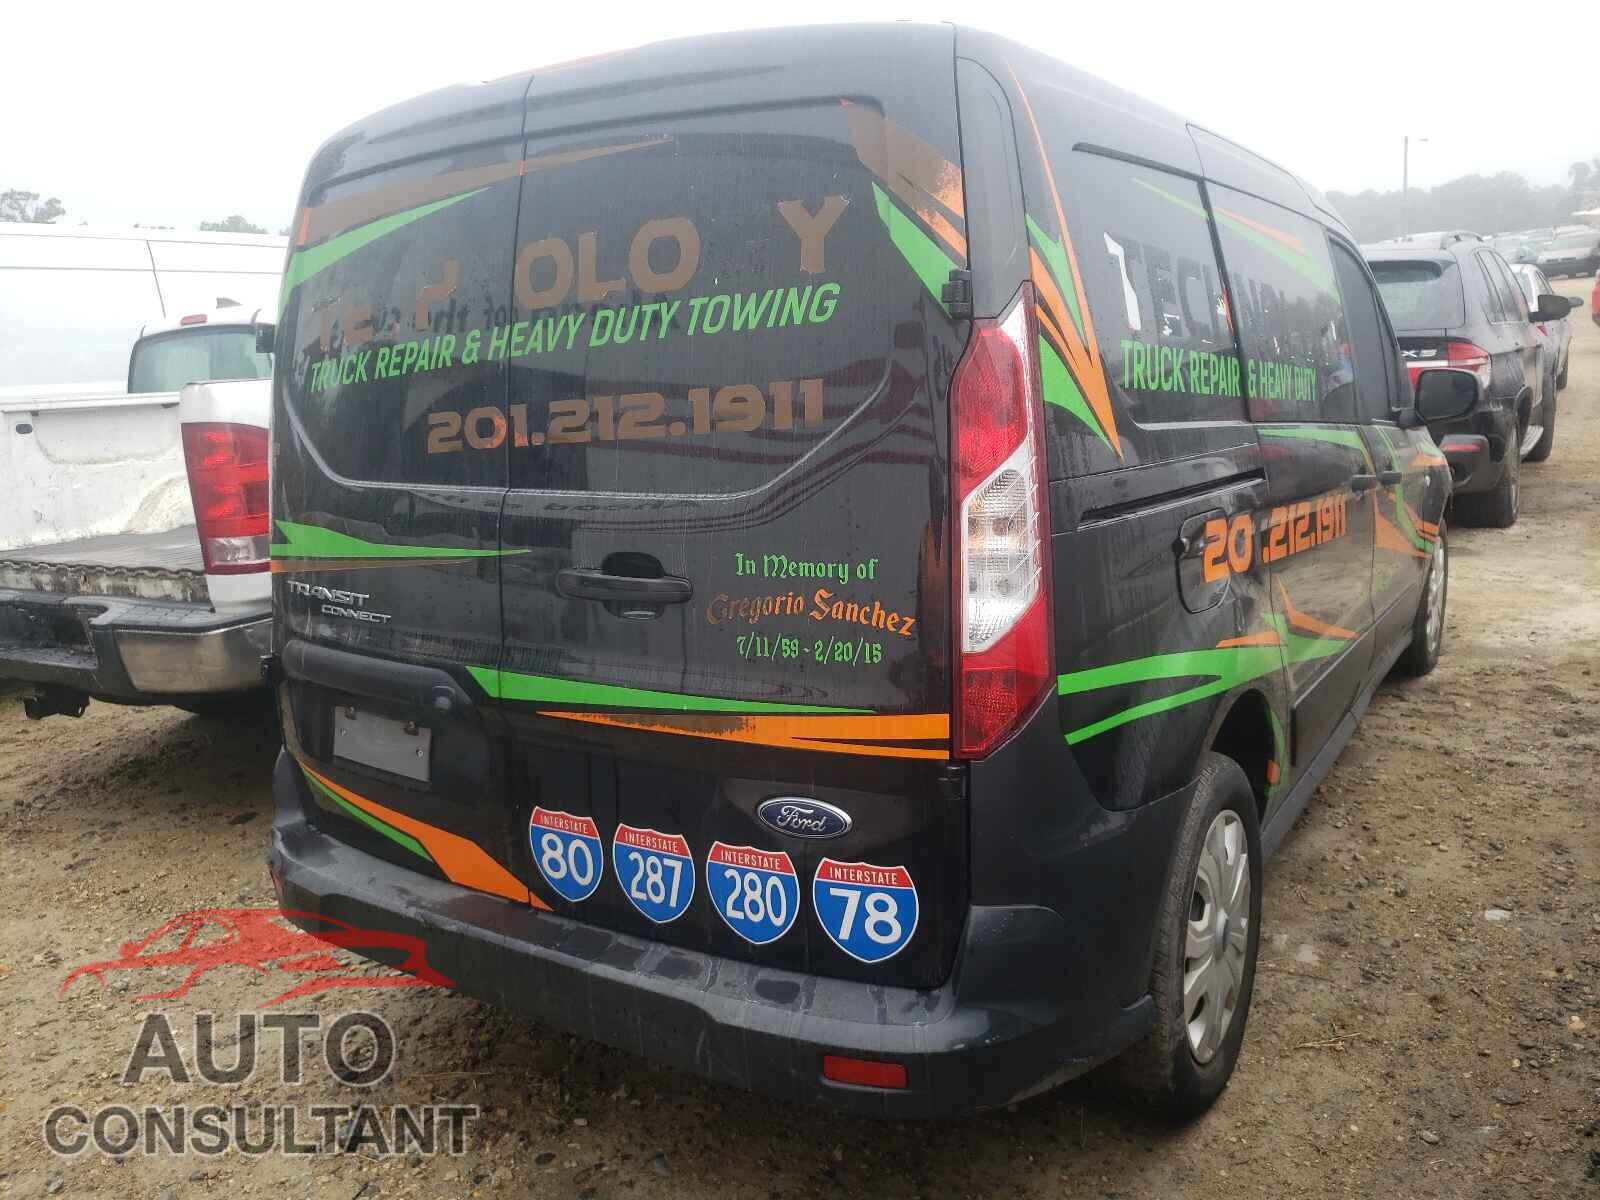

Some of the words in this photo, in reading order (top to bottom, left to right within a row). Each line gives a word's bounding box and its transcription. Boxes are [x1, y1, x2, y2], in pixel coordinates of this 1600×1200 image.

[310, 350, 371, 393] TRUCK
[374, 334, 456, 380] REPAIR
[461, 329, 481, 364] &
[487, 312, 587, 360] HEAVY
[589, 300, 680, 347] DUTY
[687, 282, 841, 336] TOWING
[1119, 339, 1186, 393] TRUCK
[1189, 350, 1240, 397] REPAIR
[1259, 360, 1292, 400] HEAVY
[1295, 365, 1317, 402] DUTY
[427, 377, 824, 454] 201.212.1911
[1203, 494, 1346, 584] 20.212.1911
[735, 552, 756, 577] In
[763, 553, 849, 585] Memory
[856, 558, 879, 580] of
[287, 580, 369, 607] TRANSIT
[321, 604, 391, 624] CONNECT
[707, 591, 805, 625] Gregorio
[809, 588, 916, 637] Sanchez
[539, 813, 590, 835] INTERSTATE
[624, 831, 679, 853] INTERSTATE
[775, 807, 826, 833] Ford
[540, 832, 594, 886] 80
[628, 851, 683, 908] 287
[719, 850, 782, 870] INTERSTATE
[828, 866, 899, 885] INTERSTATE
[724, 868, 787, 927] 280
[829, 887, 902, 944] 78
